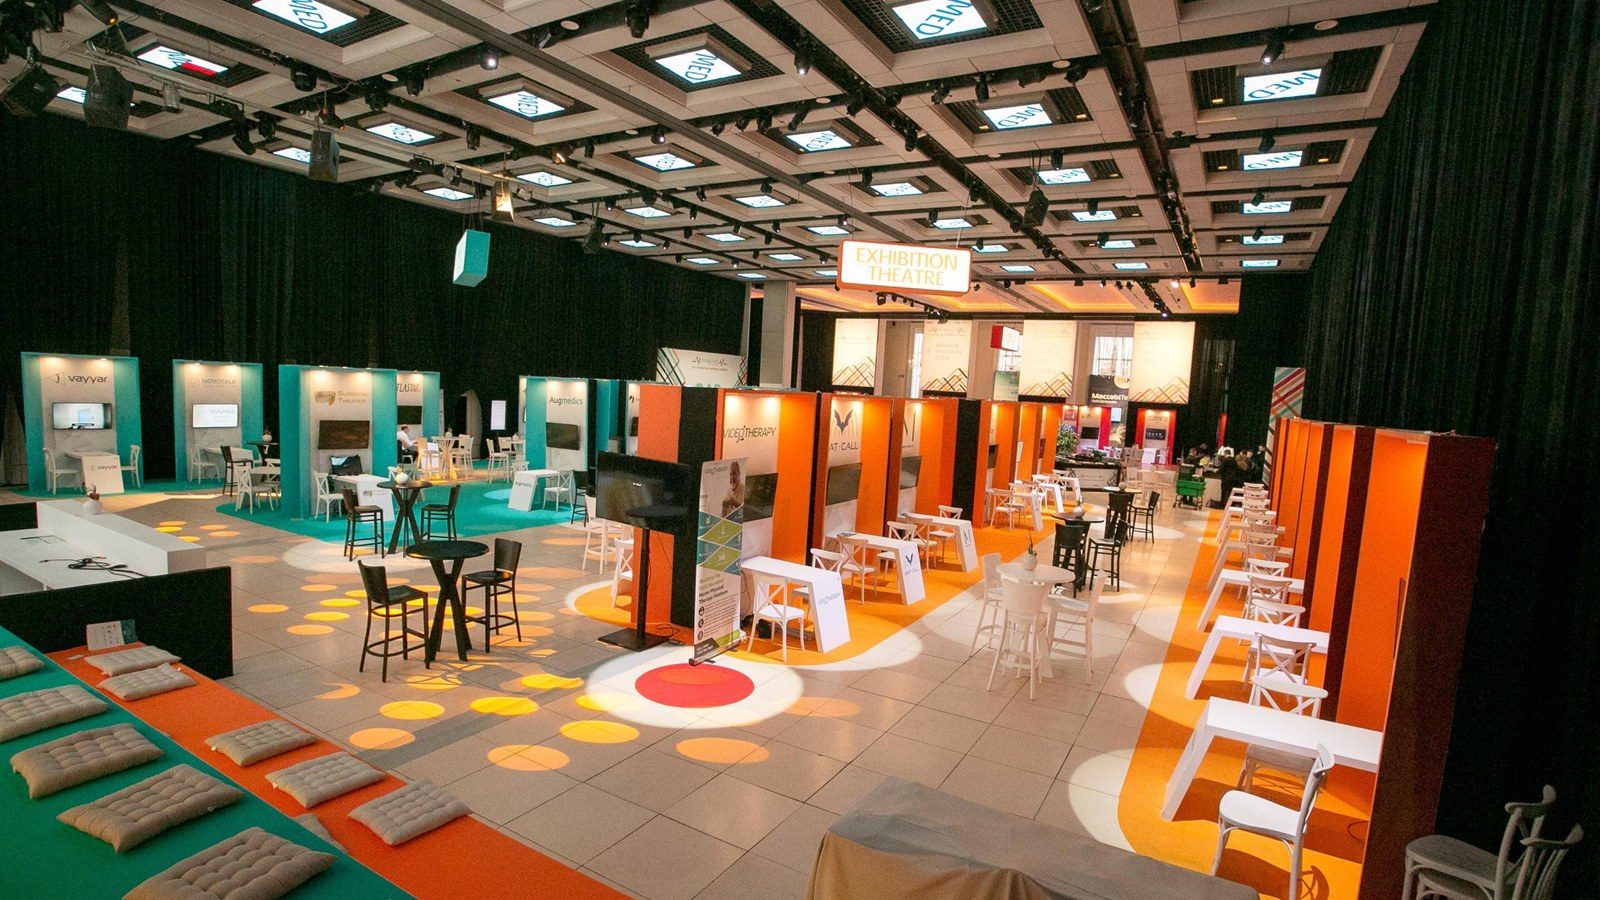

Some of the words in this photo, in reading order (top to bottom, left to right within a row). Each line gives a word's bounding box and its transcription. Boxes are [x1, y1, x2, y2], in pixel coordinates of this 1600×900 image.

[856, 247, 958, 270] EXHIBITION
[869, 265, 945, 286] THEATRE
[68, 375, 108, 384] vayyar
[549, 396, 583, 405] Augmedics
[1091, 392, 1129, 401] MaccabiTe
